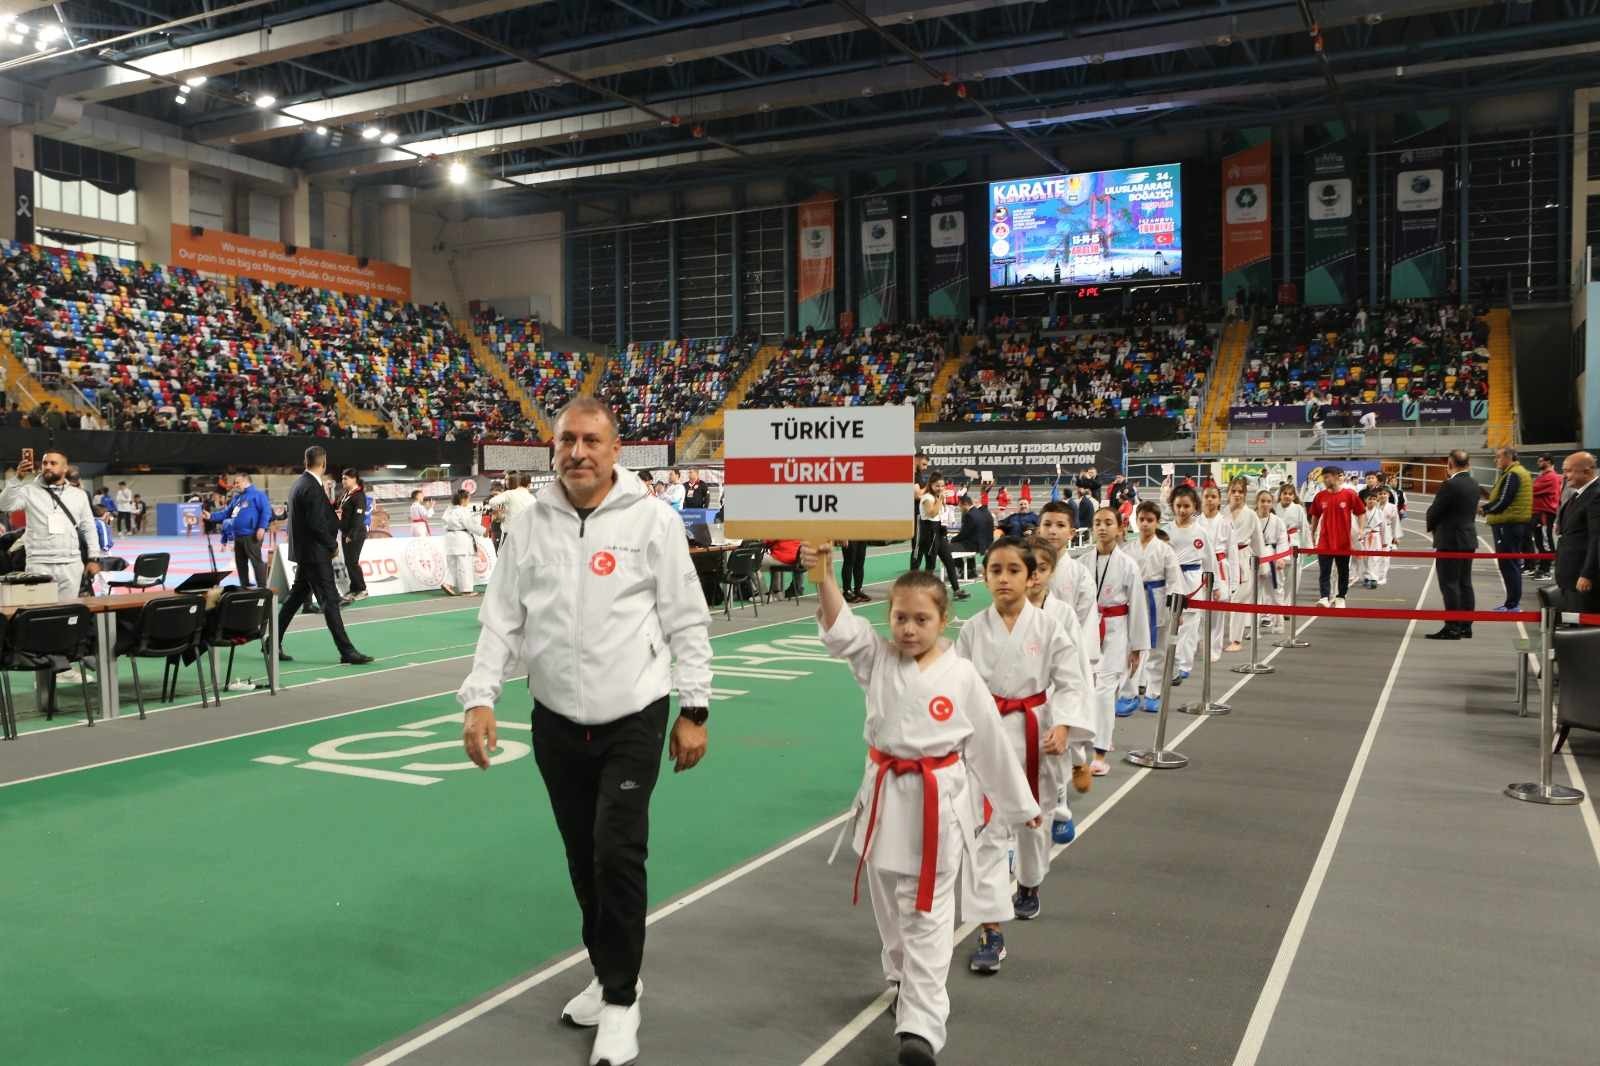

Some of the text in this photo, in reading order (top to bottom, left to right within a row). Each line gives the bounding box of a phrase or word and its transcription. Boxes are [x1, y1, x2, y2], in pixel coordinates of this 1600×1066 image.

[993, 180, 1065, 201] KARATE
[1104, 181, 1172, 195] ULUSLARARASI
[179, 249, 196, 260] Our
[238, 258, 252, 272] big
[771, 416, 864, 440] TÜRKİYE
[920, 442, 1102, 455] TÜRKİYE KARATE FEDERASYONU
[770, 458, 865, 482] TÜRKİYE
[928, 454, 1096, 466] TURKISH KARATE FEDERATION
[795, 494, 838, 513] TUR
